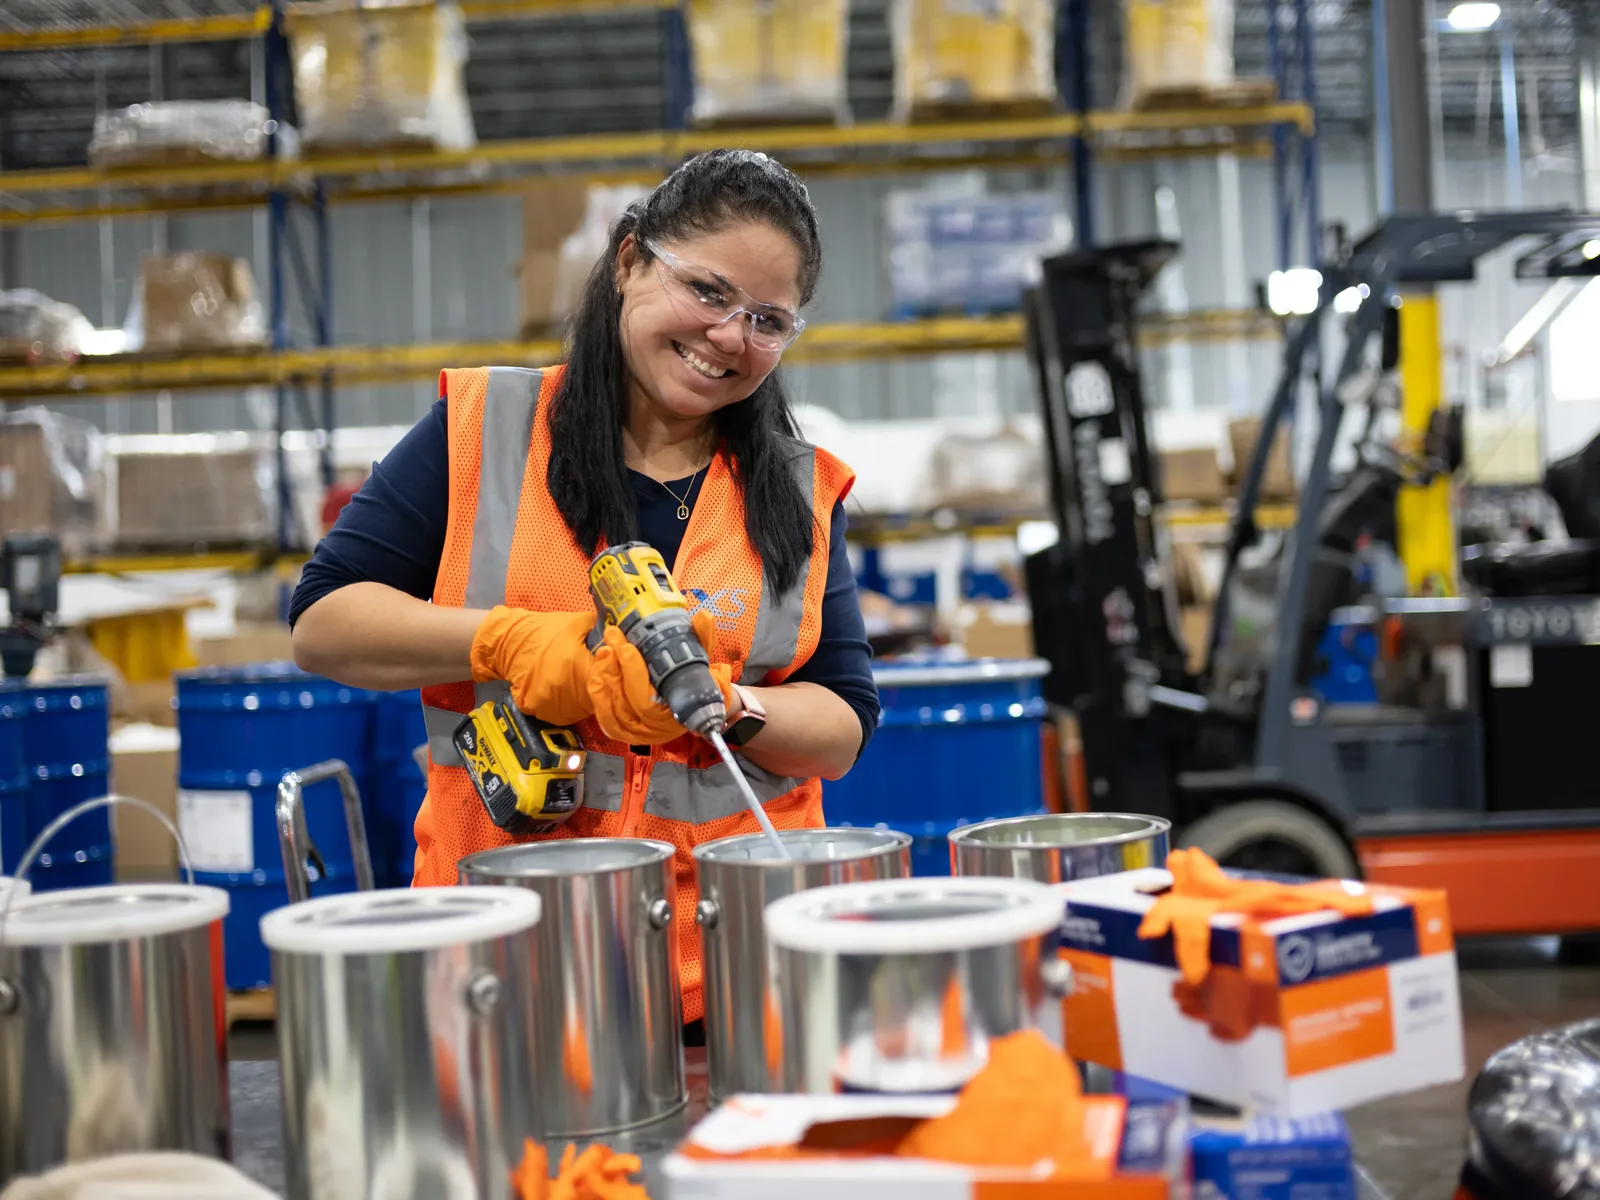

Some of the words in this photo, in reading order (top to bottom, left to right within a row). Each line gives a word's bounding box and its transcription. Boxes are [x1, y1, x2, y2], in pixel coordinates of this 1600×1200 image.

[681, 588, 748, 618] XS
[1490, 606, 1597, 639] TOYOT
[488, 776, 500, 790] 5
